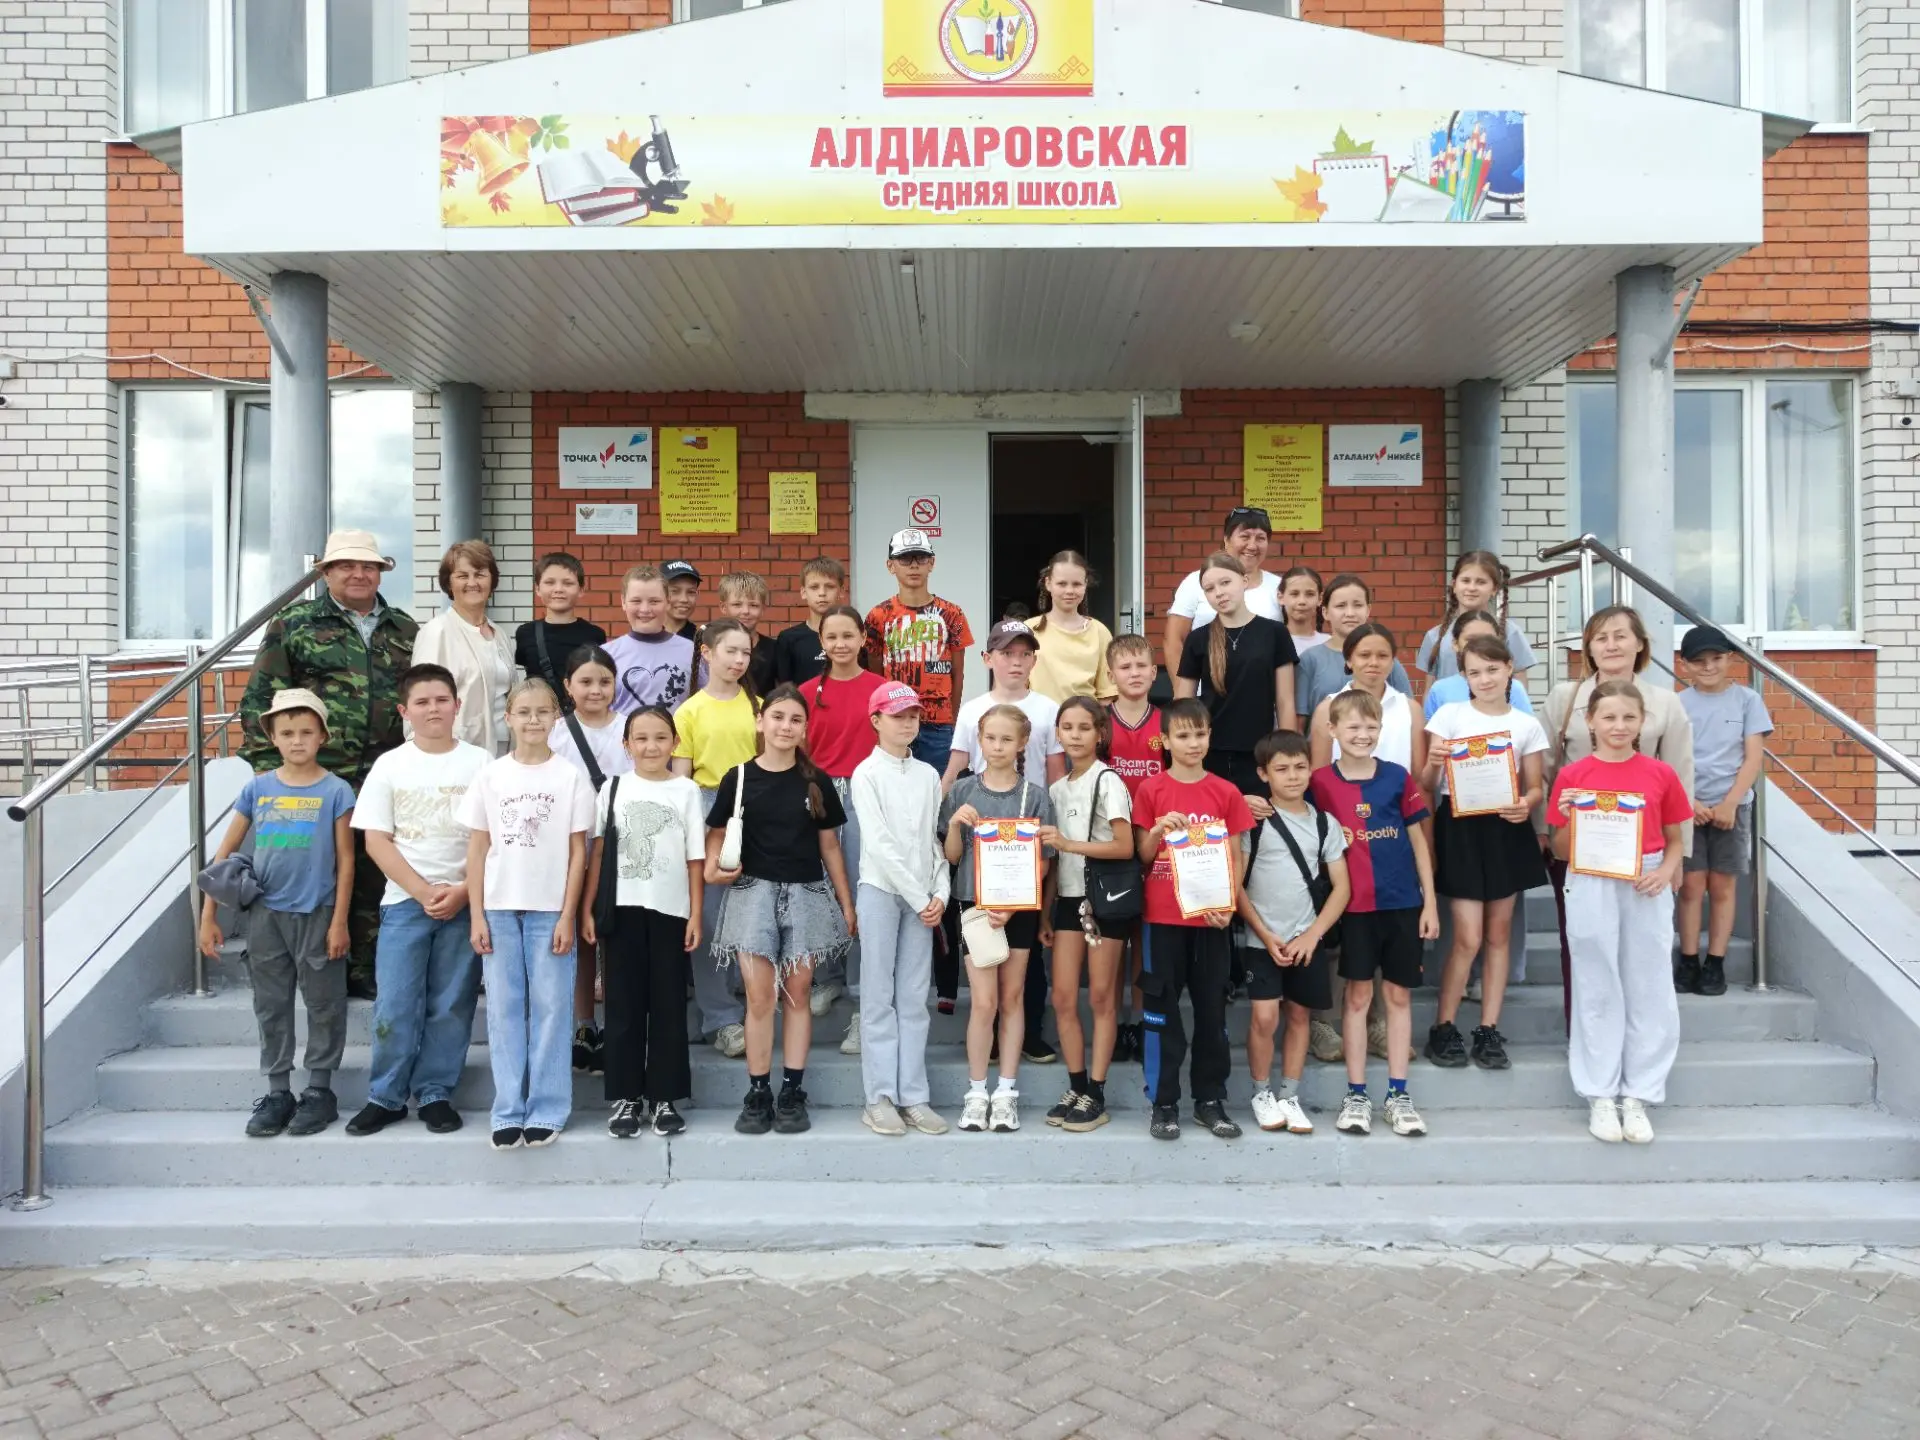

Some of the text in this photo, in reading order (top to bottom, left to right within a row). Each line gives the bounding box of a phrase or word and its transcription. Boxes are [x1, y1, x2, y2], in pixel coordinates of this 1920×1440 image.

[810, 125, 1186, 175] АЛДИАРОВСКАЯ
[883, 181, 1117, 210] СРЕДНЯЯ ШКОЛА
[563, 454, 648, 463] ТОЧКА РОСТА
[1113, 756, 1146, 768] Team
[1459, 757, 1502, 769] ГРАМОТА
[1584, 813, 1630, 823] ГРАМОТА
[1356, 826, 1399, 842] Spotify
[987, 844, 1028, 853] ГРАМОТА
[1181, 847, 1220, 859] ГРАМОТА
